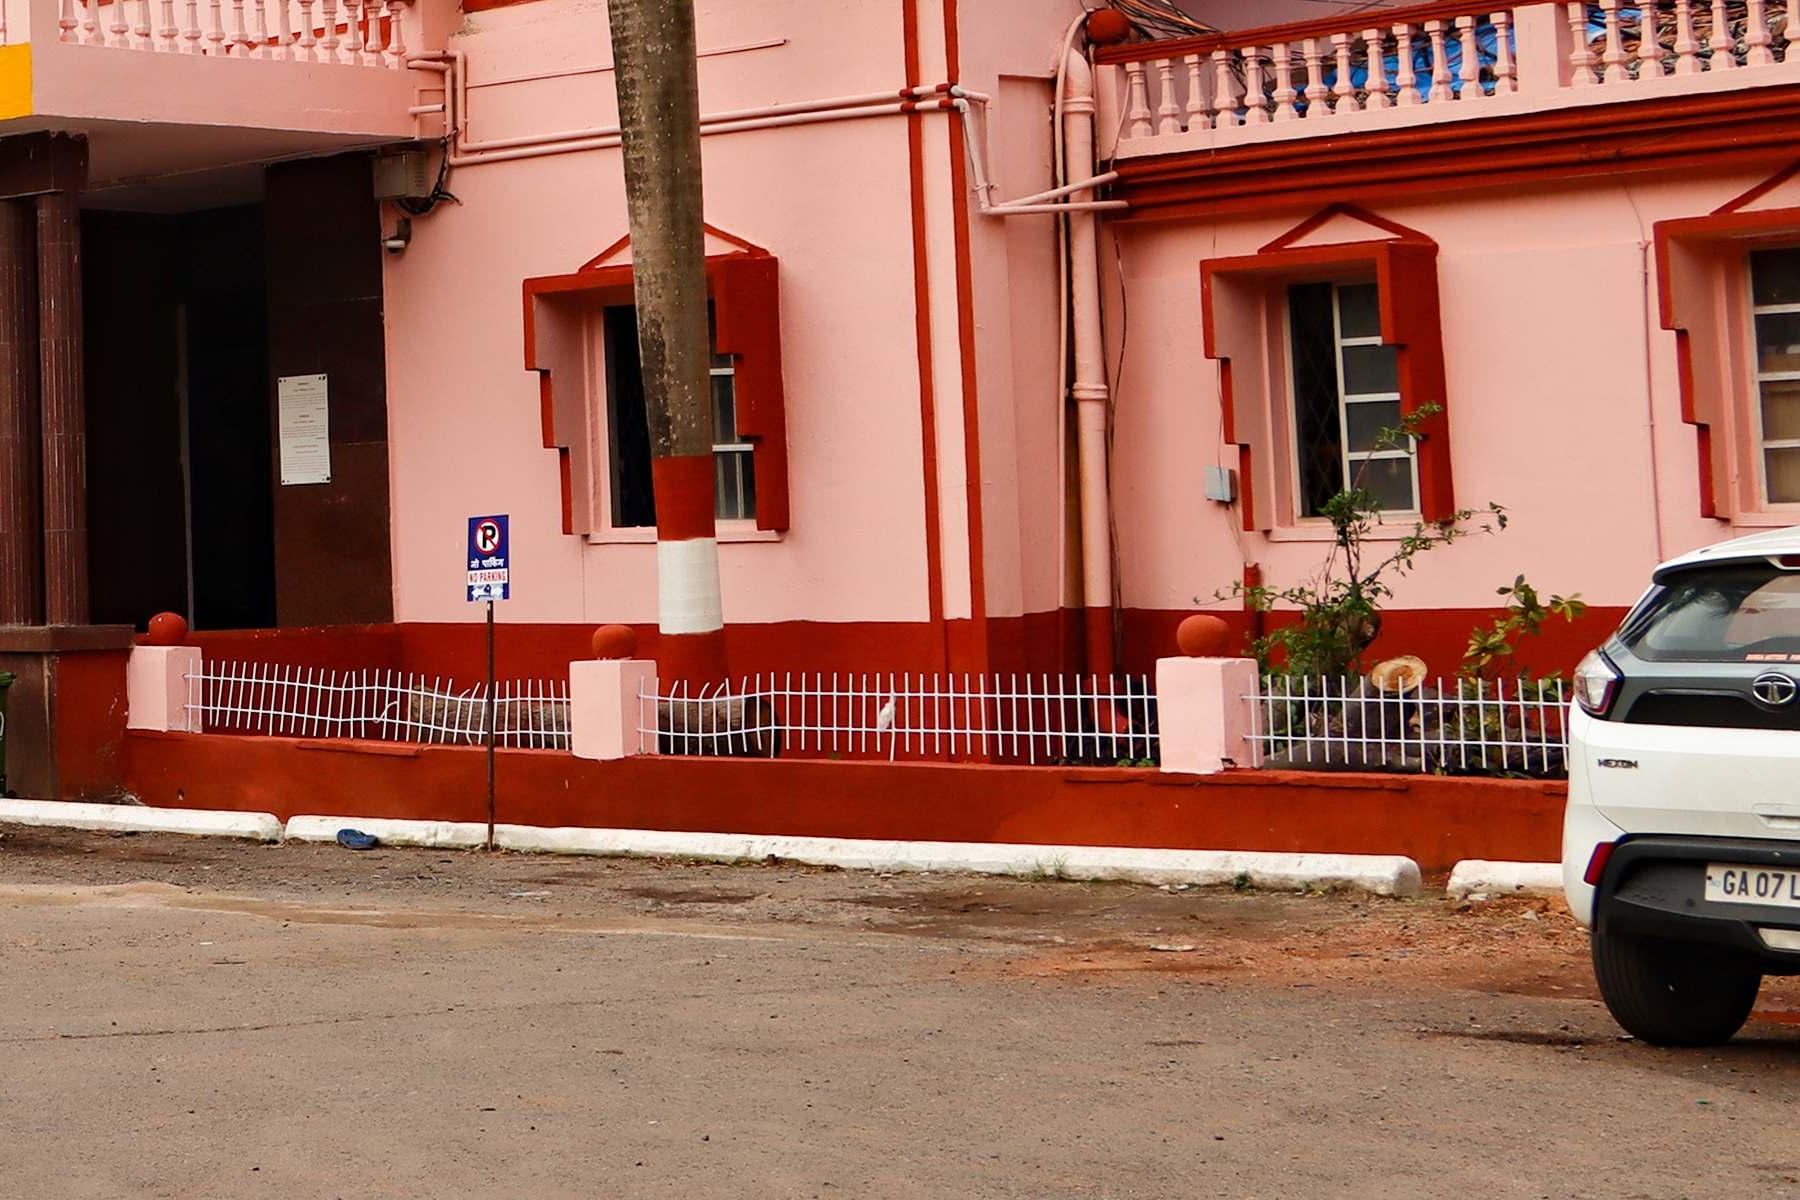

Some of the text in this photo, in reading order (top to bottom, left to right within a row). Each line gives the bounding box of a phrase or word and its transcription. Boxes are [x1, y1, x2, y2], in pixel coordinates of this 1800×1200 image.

[469, 571, 506, 583] NO PARKING
[1723, 870, 1749, 896] GA
[1756, 872, 1785, 898] 07
